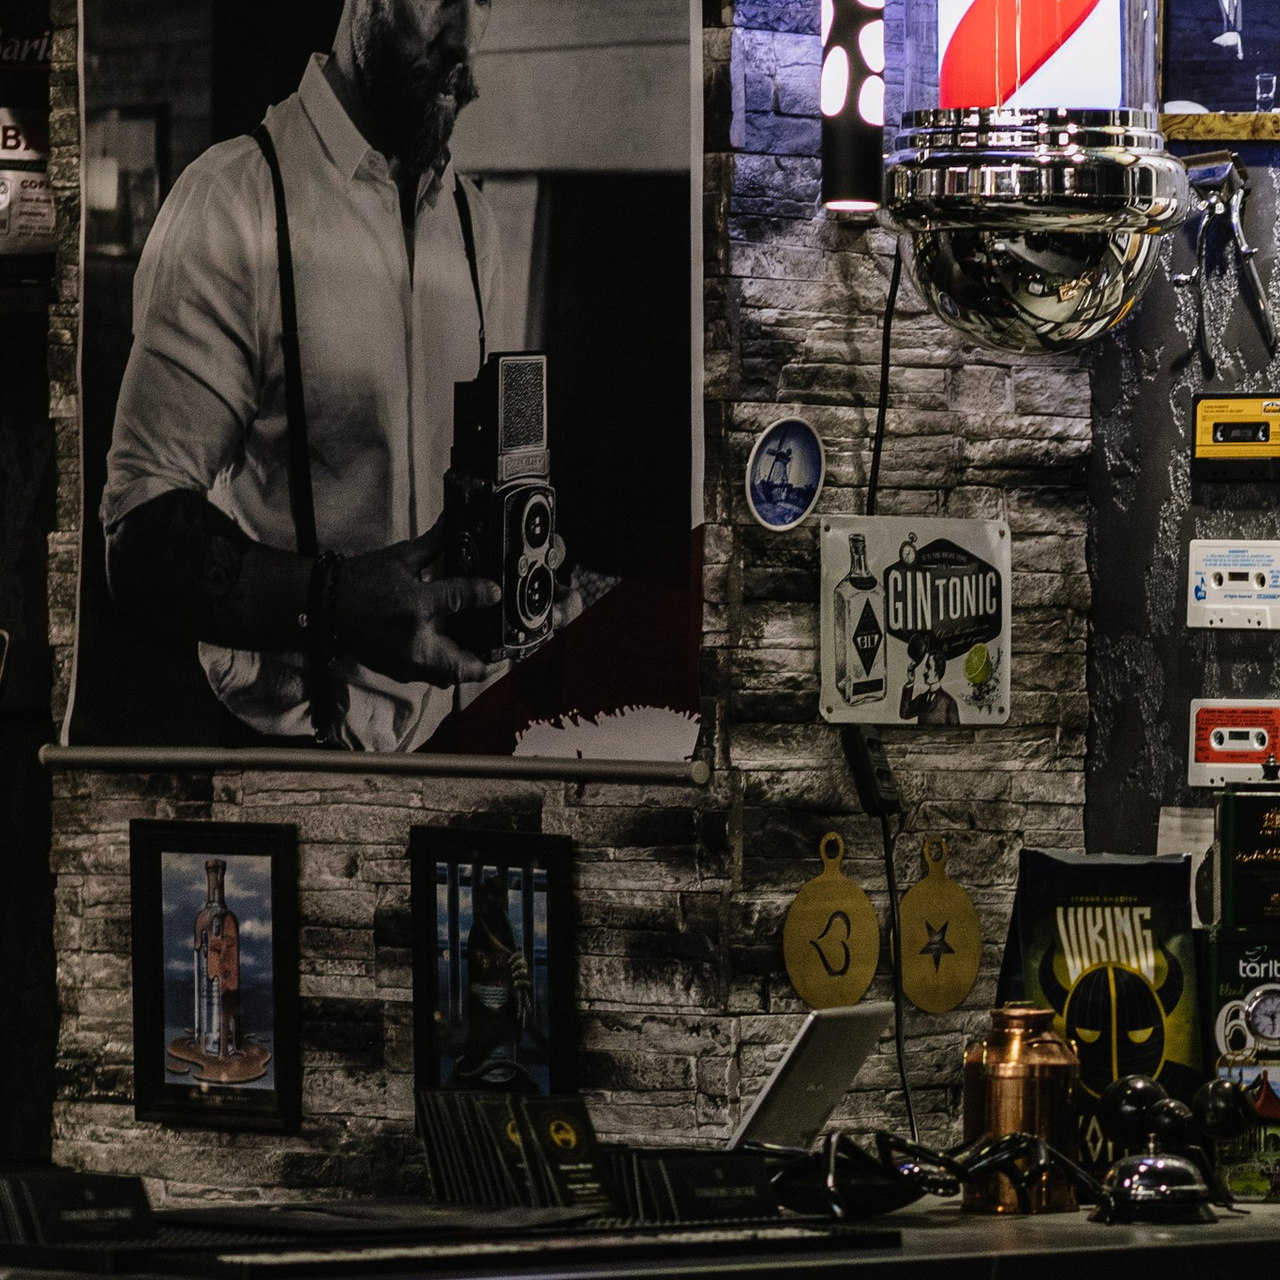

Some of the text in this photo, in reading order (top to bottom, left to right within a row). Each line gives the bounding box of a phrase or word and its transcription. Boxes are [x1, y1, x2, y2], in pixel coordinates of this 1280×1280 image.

[0, 28, 51, 61] ari
[888, 569, 997, 631] GIN TONIC
[859, 635, 877, 649] GIN
[1056, 906, 1154, 985] VIKING
